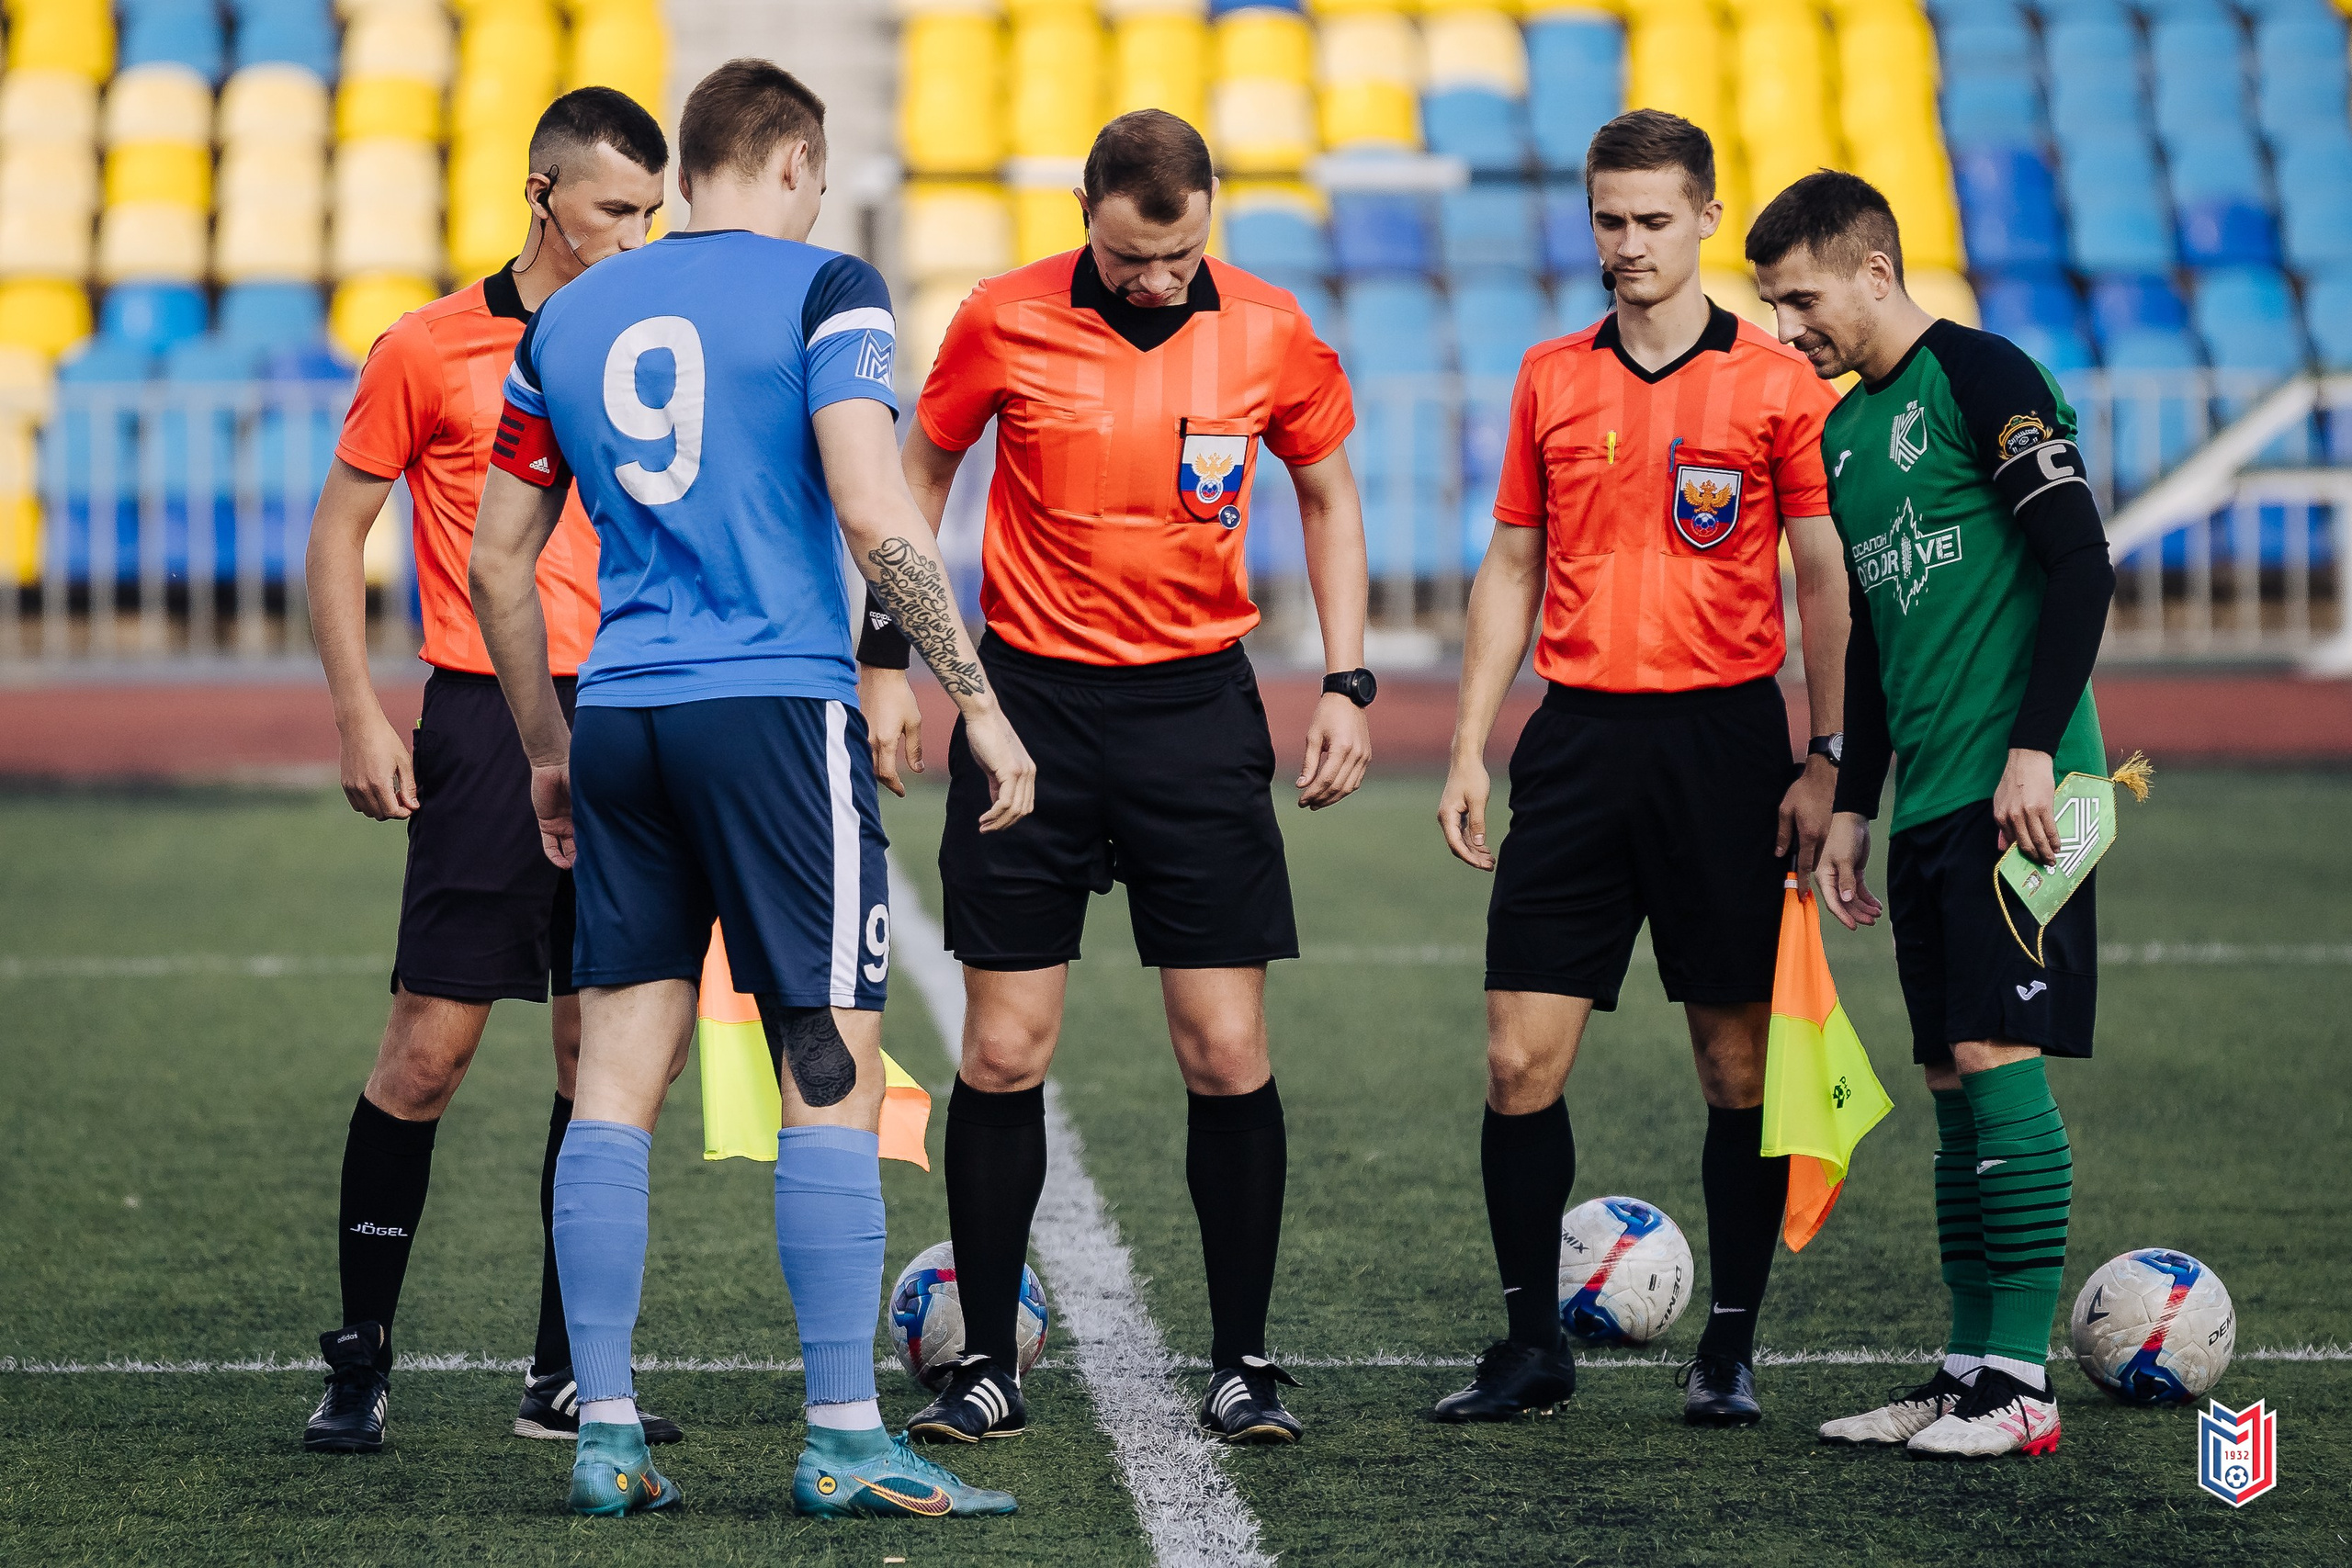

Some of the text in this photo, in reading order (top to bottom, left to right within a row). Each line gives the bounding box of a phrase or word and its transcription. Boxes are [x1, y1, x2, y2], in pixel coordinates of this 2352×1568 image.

[603, 315, 706, 505] 9
[2036, 445, 2075, 479] C
[864, 904, 891, 983] 9
[350, 1222, 408, 1236] JÖGEL
[1562, 1227, 1590, 1254] MIX
[1656, 1264, 1682, 1332] DEMIX
[337, 1332, 358, 1343] adidas
[2208, 1309, 2233, 1347] DEM
